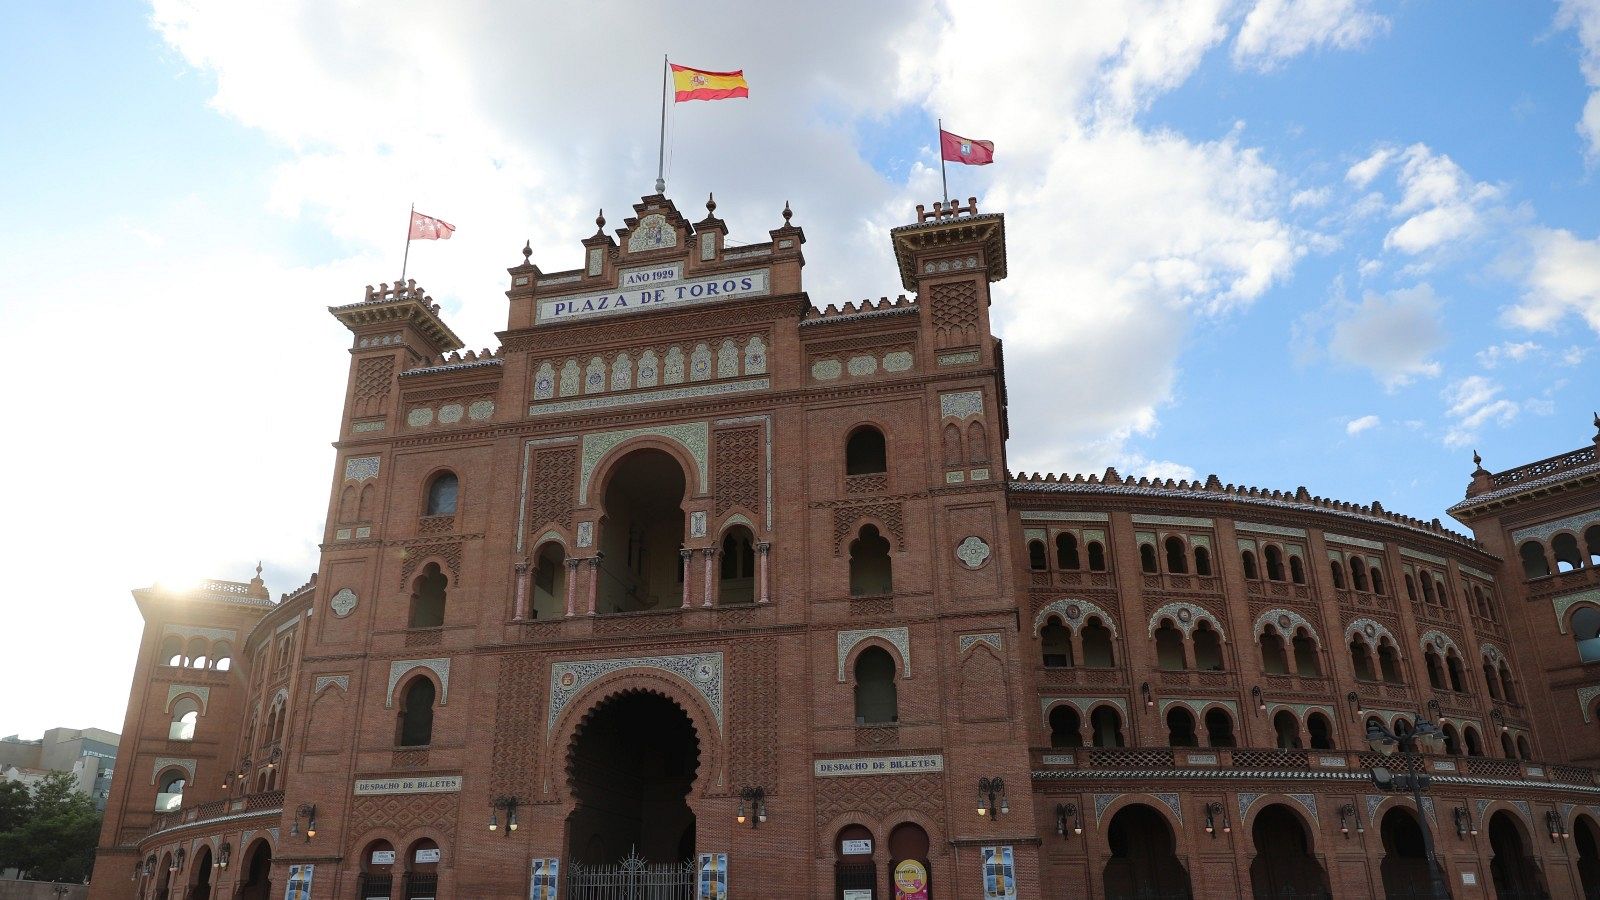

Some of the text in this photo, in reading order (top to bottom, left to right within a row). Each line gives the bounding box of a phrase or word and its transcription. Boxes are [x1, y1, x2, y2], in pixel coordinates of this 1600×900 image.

[627, 269, 674, 285] AÑO 1929
[554, 277, 753, 316] PLAZA DE TOROS
[820, 759, 937, 772] DESPACHO DE BILLETES
[359, 780, 457, 791] DESPACHO DE BILLETES
